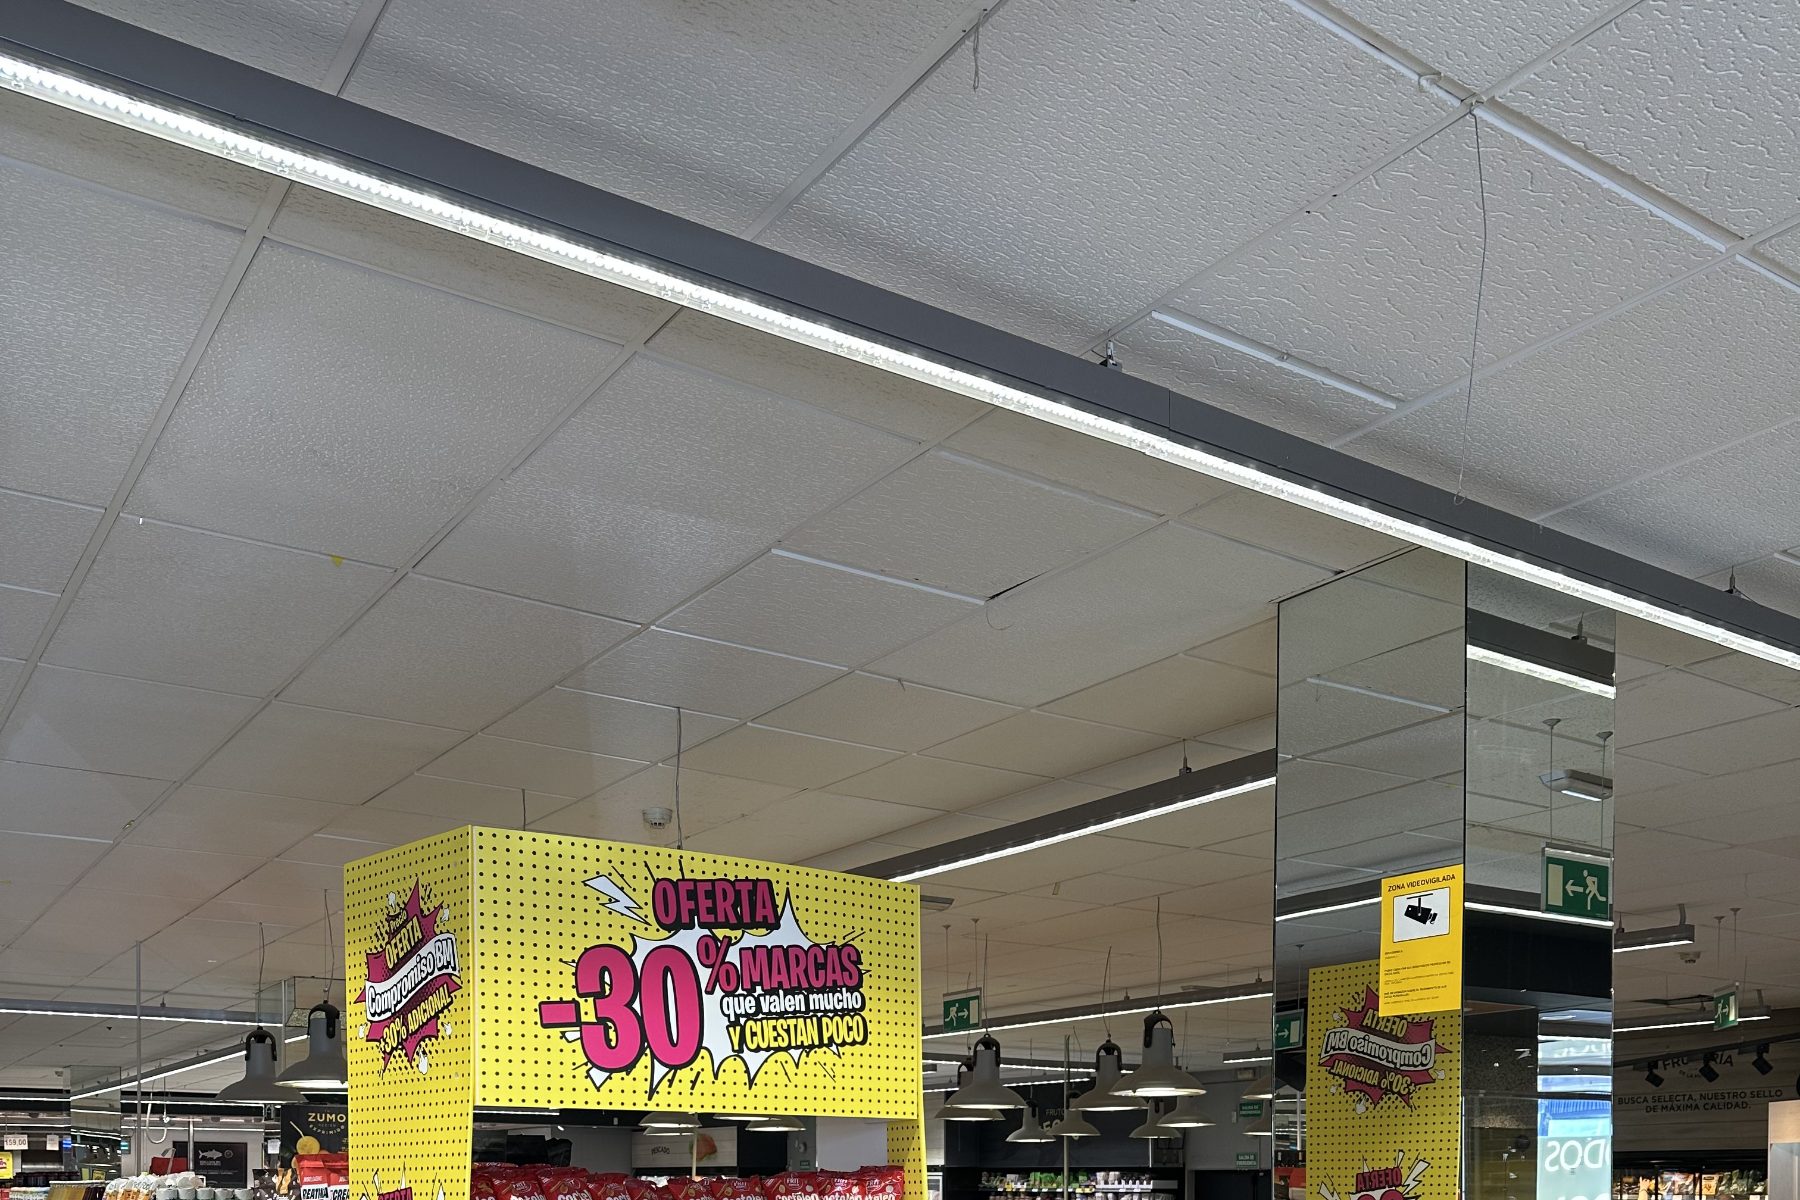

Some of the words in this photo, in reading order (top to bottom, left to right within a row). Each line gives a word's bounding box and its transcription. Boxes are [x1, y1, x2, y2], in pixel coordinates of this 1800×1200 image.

[1387, 883, 1406, 892] ZONA
[1407, 873, 1456, 889] VIDEOVIGILADA
[653, 879, 779, 927] OFERTA
[385, 914, 423, 969] OFERTA
[367, 953, 434, 1017] Compromiso
[434, 937, 456, 972] BM
[740, 945, 862, 992] MARCAS
[379, 1015, 407, 1053] +30%
[408, 983, 453, 1035] ADICIONAL
[721, 995, 757, 1017] que
[758, 992, 807, 1013] valen
[808, 989, 862, 1011] mucho
[727, 1023, 744, 1049] Y
[744, 1020, 819, 1051] CUESTAN
[820, 1018, 865, 1045] POCO
[1618, 1096, 1649, 1105] BUSCA
[1700, 1091, 1747, 1101] NUESTRO
[1750, 1089, 1783, 1099] SELLO
[1645, 1105, 1658, 1113] DE
[1661, 1102, 1700, 1113] MÁXIMA
[307, 1112, 347, 1122] ZUMO
